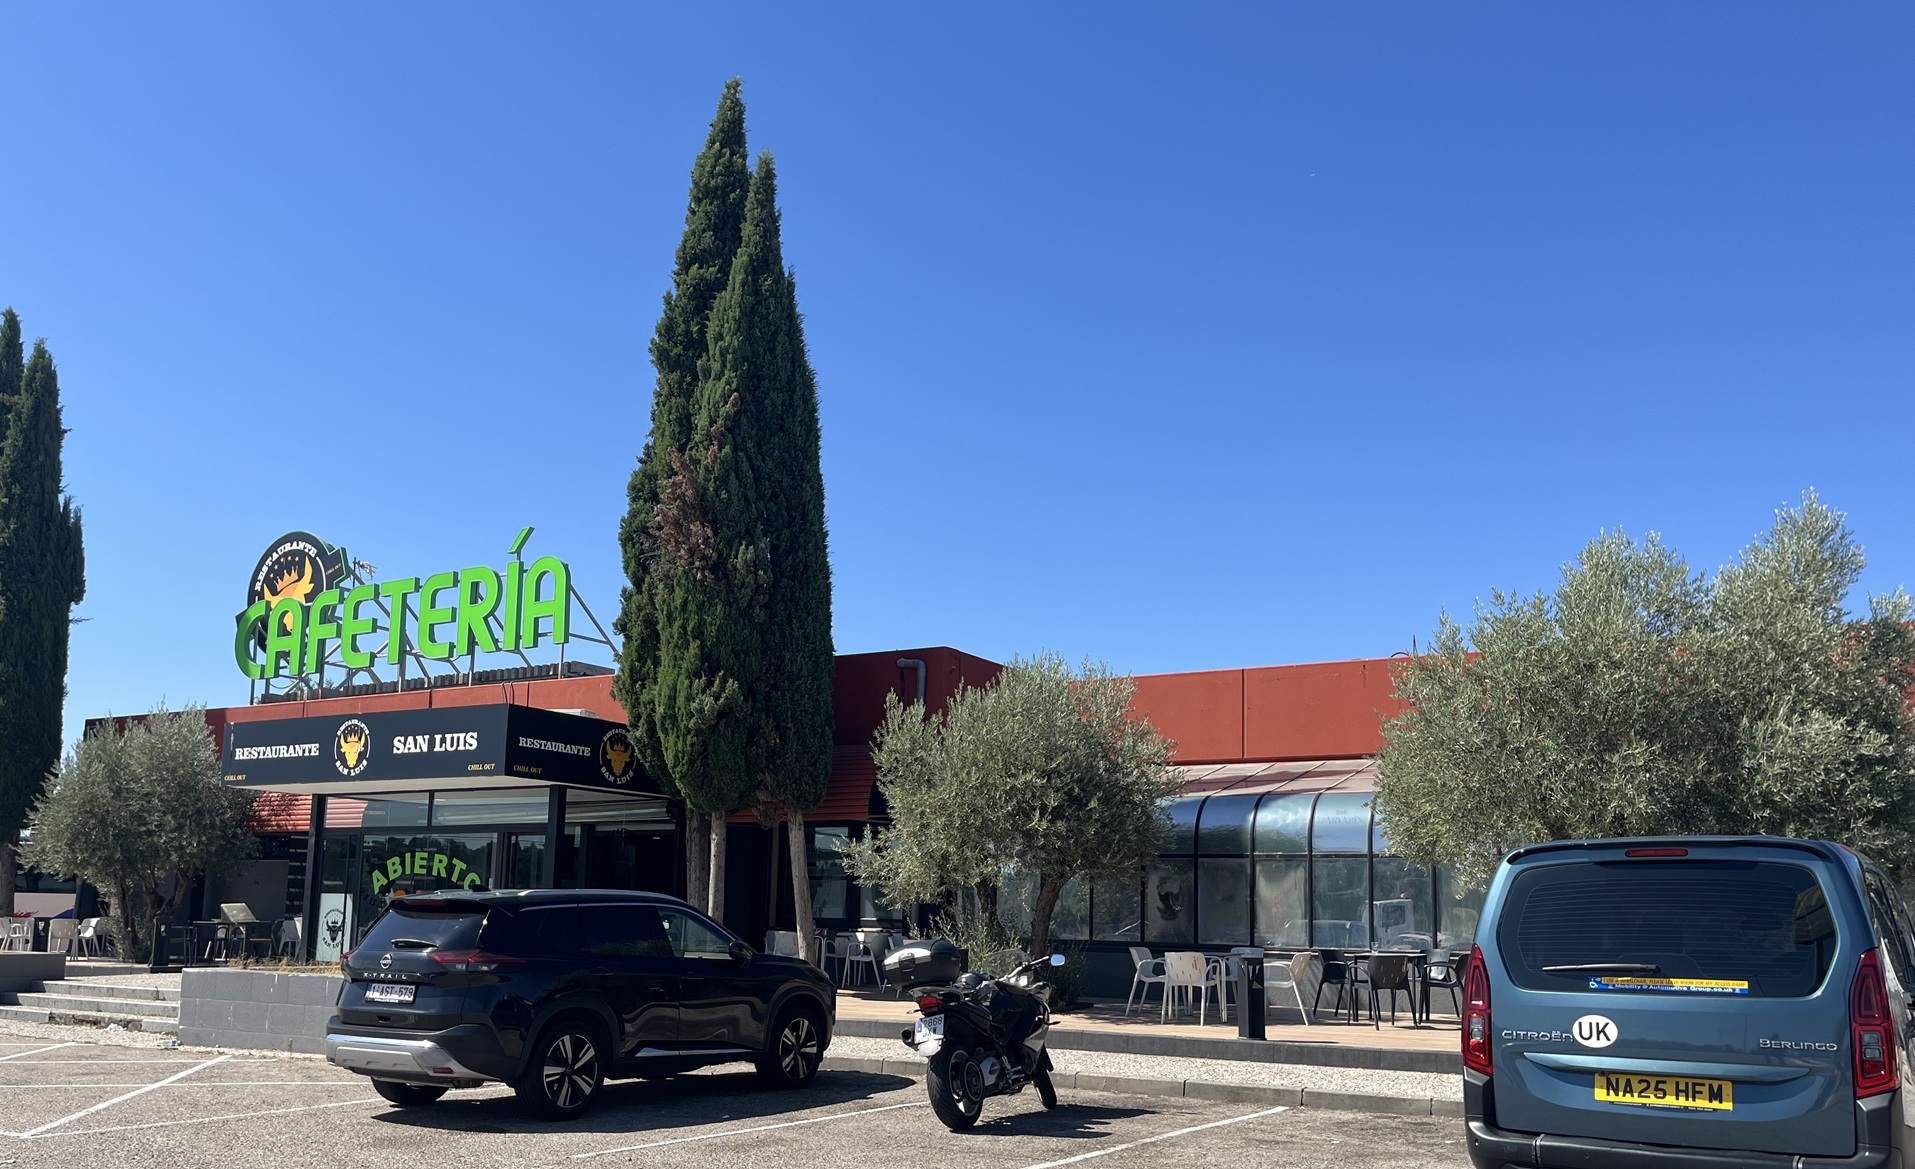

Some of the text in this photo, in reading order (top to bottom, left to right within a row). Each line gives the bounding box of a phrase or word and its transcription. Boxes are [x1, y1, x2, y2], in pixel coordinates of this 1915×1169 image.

[254, 540, 318, 592] RESTAURANTE
[235, 526, 570, 679] CAFETERÍA
[336, 718, 370, 737] RESTAURANTE
[234, 743, 320, 760] RESTAURANTE
[392, 731, 478, 754] SAN LUIS
[518, 736, 591, 757] RESTAURANTE
[335, 759, 368, 777] SAN LUIS
[513, 764, 542, 774] CHILL OUT
[600, 766, 634, 785] SAN LUIS
[363, 972, 407, 980] X-TRAIL
[1578, 1021, 1612, 1042] UK
[1605, 1077, 1723, 1104] NA25 HFM
